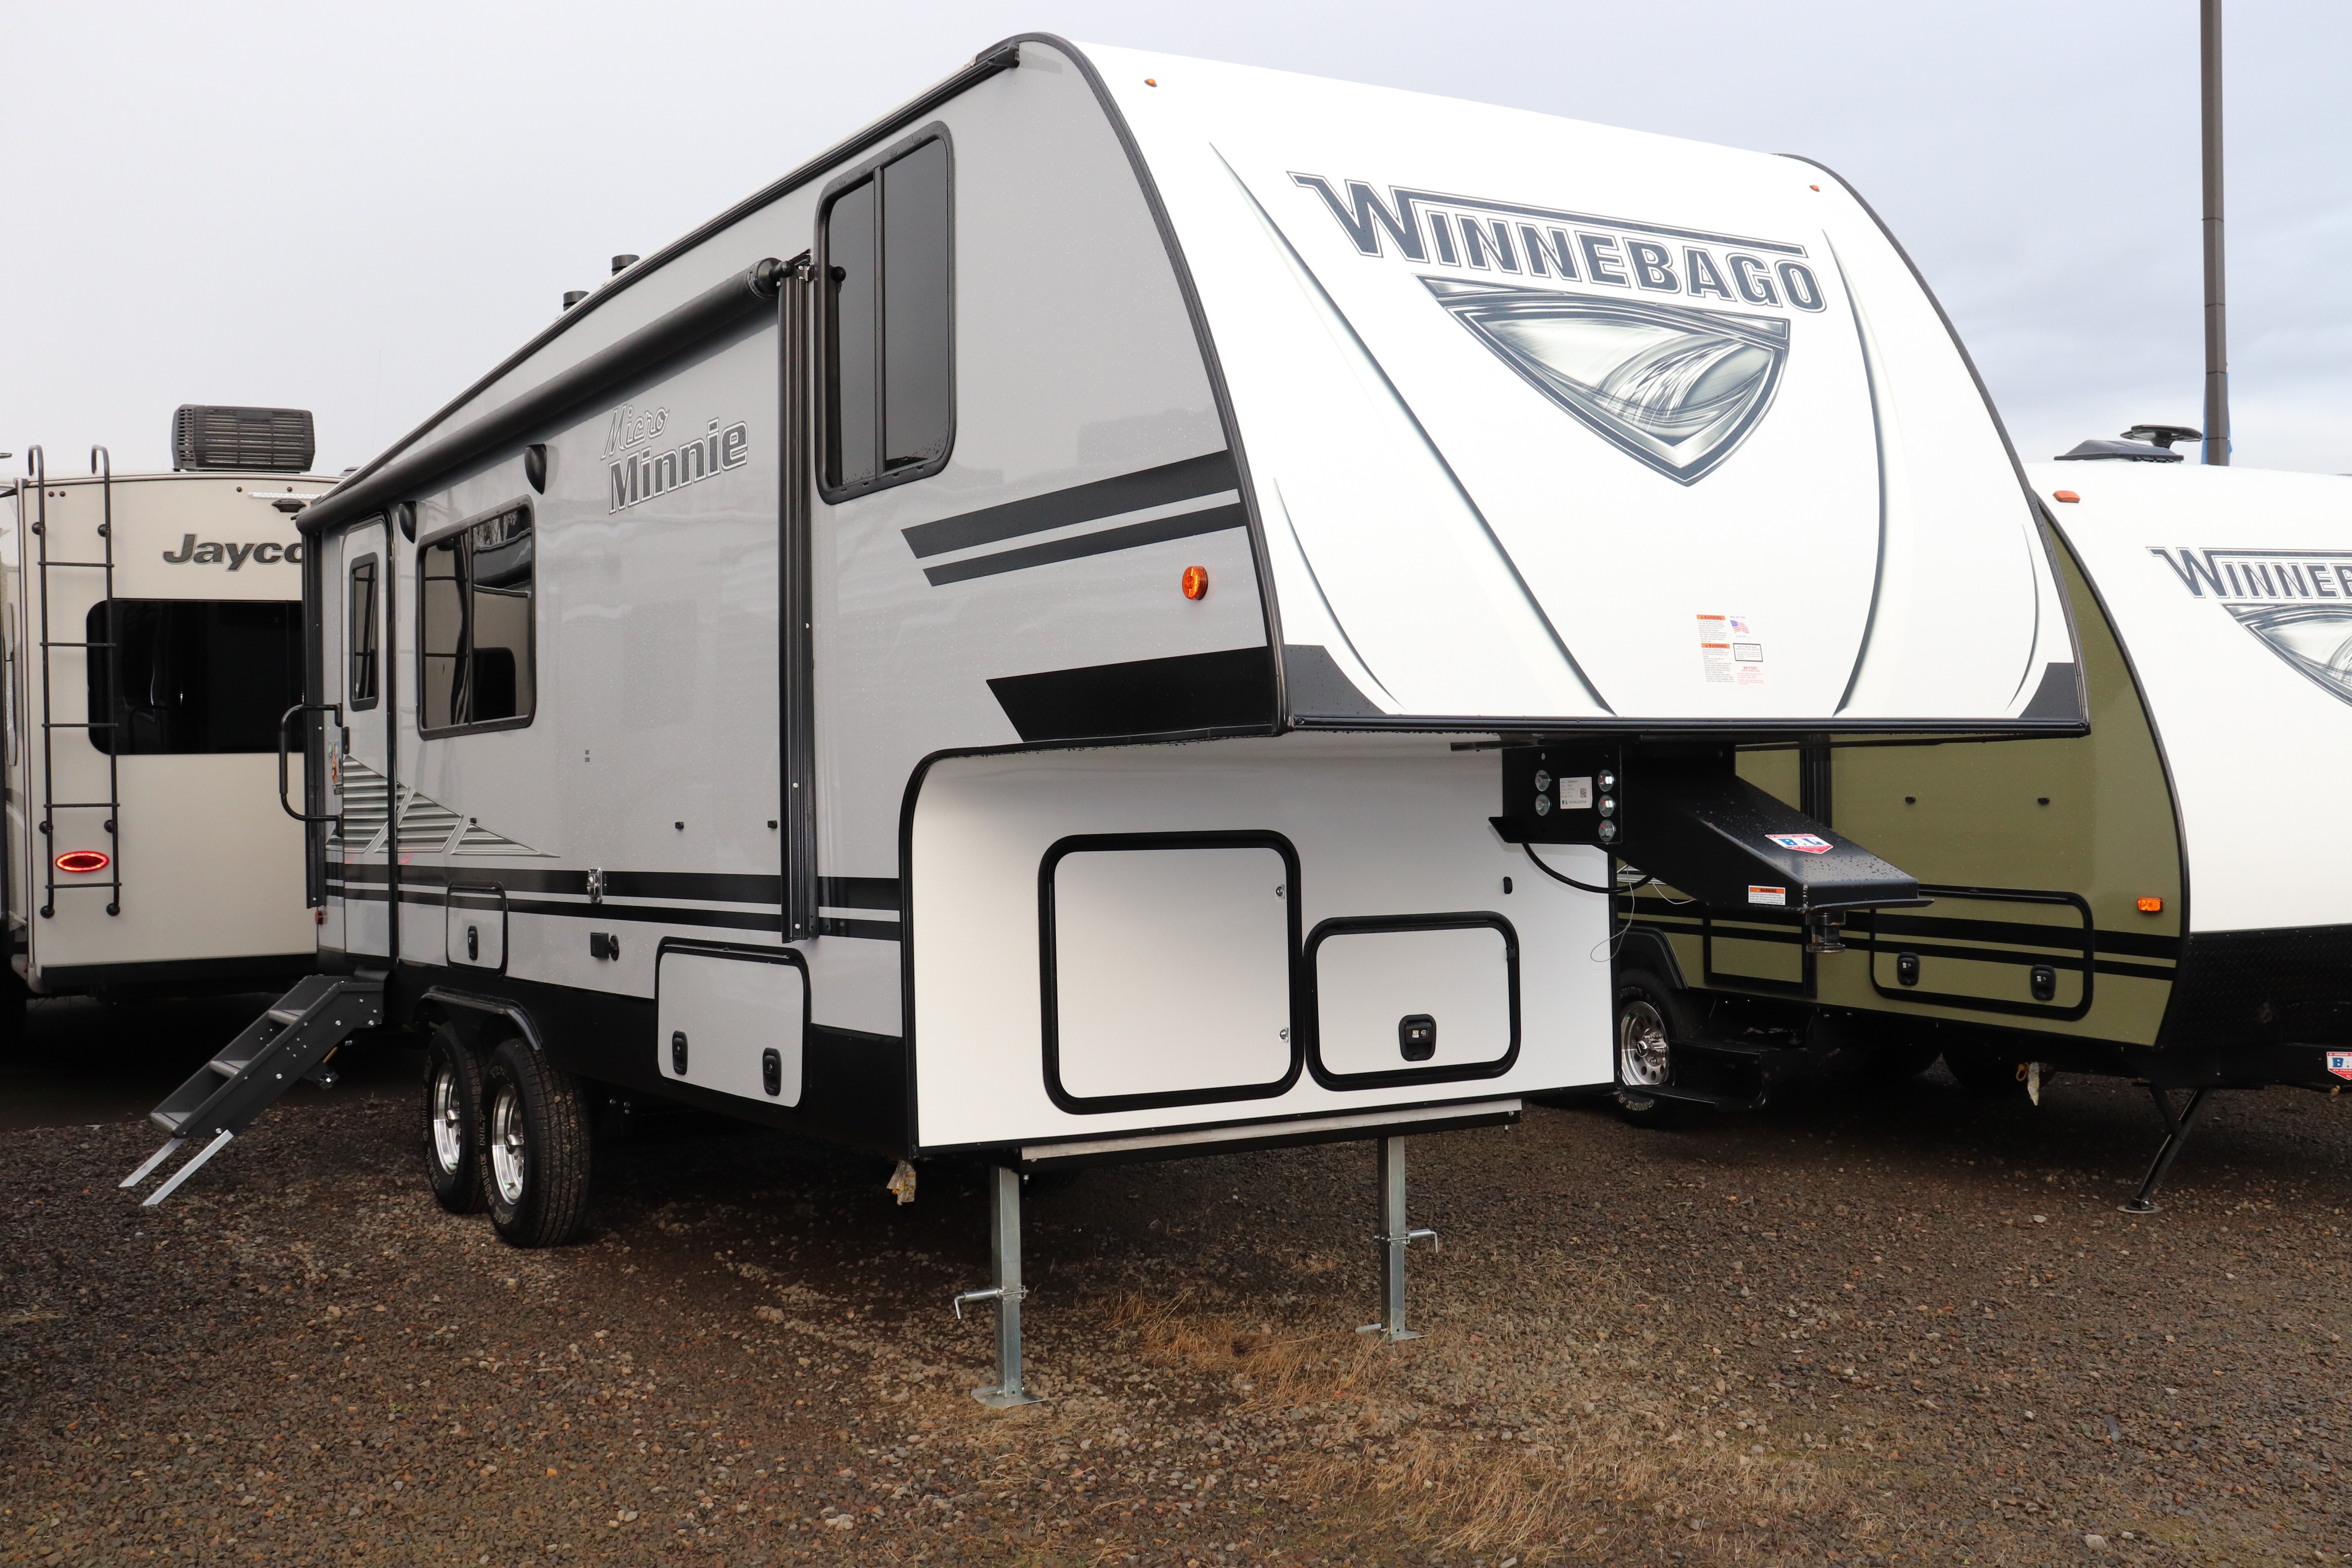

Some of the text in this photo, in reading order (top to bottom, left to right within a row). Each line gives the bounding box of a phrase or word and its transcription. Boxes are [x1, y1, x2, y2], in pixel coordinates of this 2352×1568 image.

[1285, 171, 1827, 313] WINNEBAGO
[601, 403, 670, 461] Micro
[609, 417, 748, 515] Minnie
[1626, 1099, 1654, 1111] GUIDE
[480, 1153, 494, 1206] GUIDE
